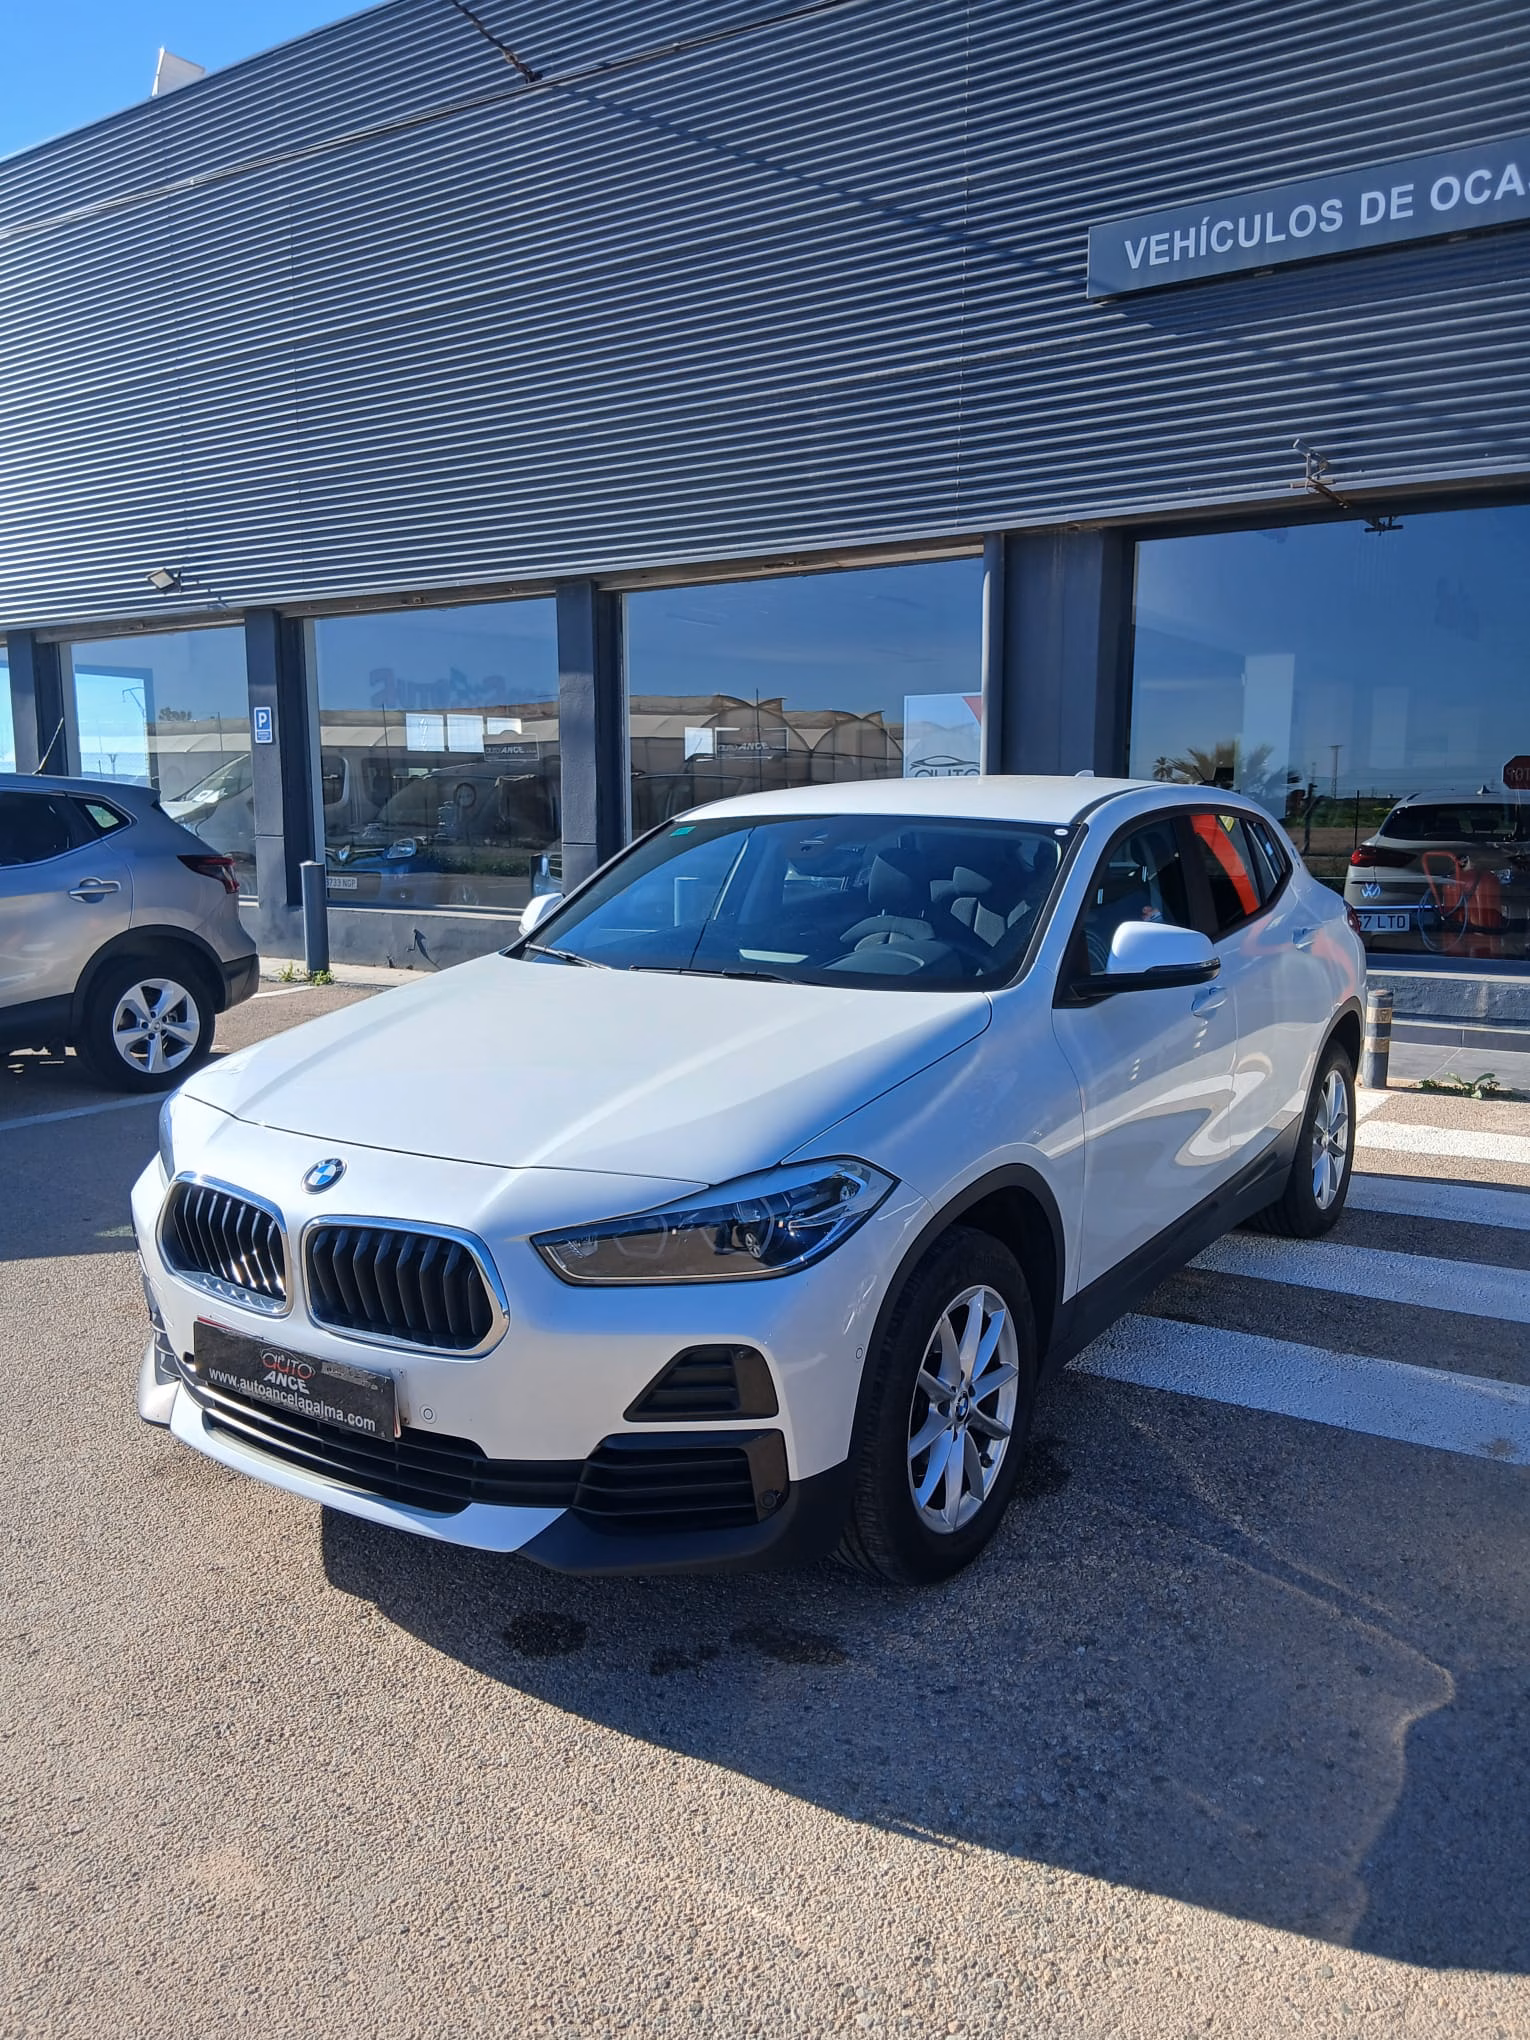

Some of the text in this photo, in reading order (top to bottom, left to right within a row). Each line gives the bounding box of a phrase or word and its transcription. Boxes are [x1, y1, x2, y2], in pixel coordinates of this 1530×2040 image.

[1124, 162, 1530, 269] VEHÍCULOS DE OCA
[258, 711, 267, 728] P
[1377, 915, 1406, 929] LTD
[263, 1371, 310, 1395] ANCE
[208, 1367, 377, 1433] www.autoancelapalma.com
